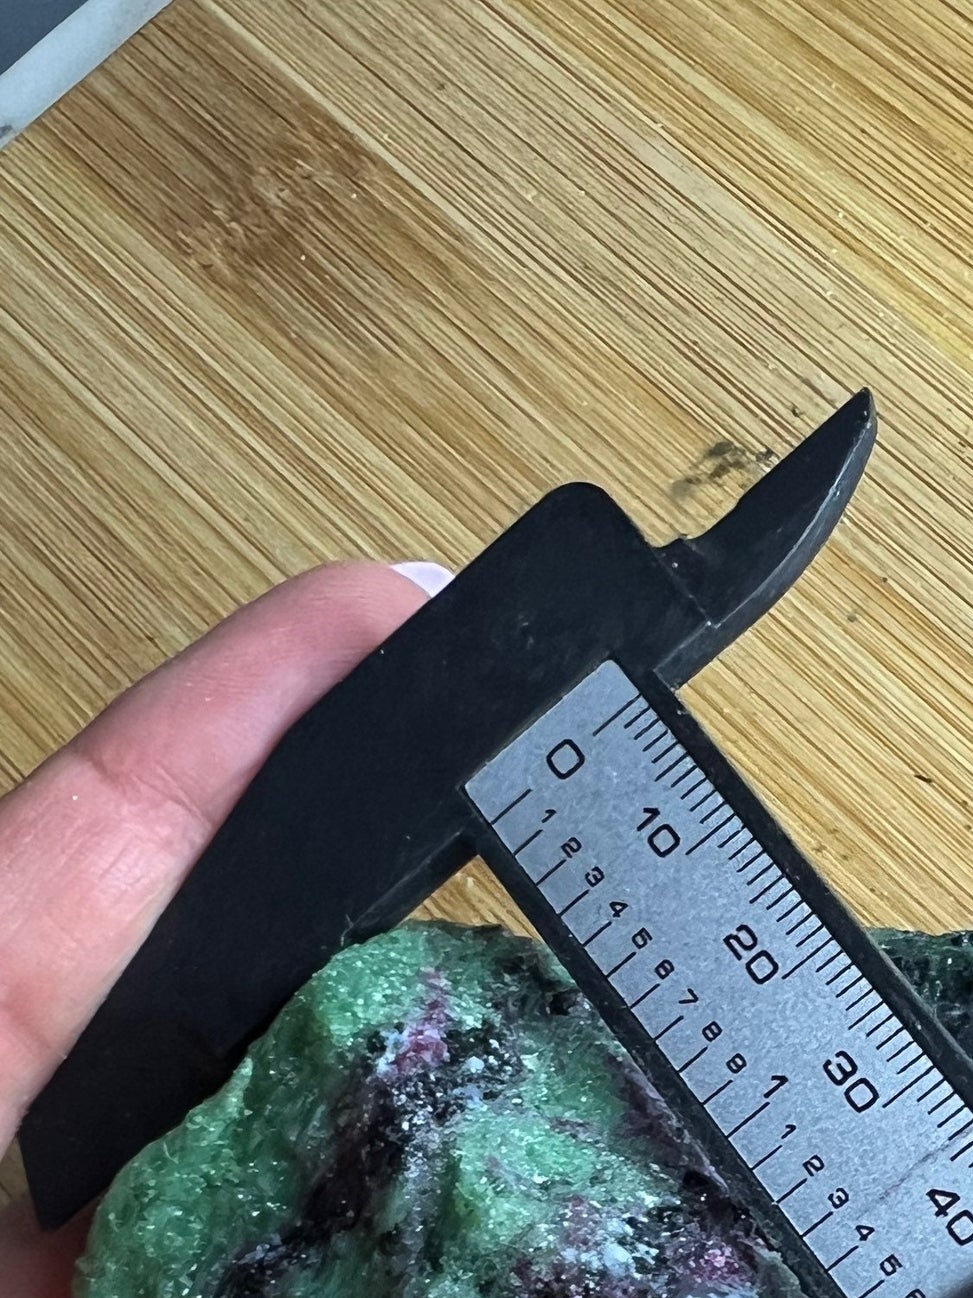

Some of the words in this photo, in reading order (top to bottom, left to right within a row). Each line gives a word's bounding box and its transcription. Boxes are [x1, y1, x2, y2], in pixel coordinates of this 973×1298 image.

[542, 809, 557, 823] 1
[560, 837, 582, 858] 2
[585, 866, 605, 887] 3
[608, 901, 629, 918] 4
[632, 928, 652, 949] 5
[679, 988, 698, 1004] 7
[702, 1021, 722, 1042] 8
[763, 1075, 788, 1098] 1
[781, 1124, 796, 1139] 1
[802, 1155, 824, 1176] 2
[828, 1188, 849, 1209] 3
[855, 1225, 875, 1241] 4
[880, 1254, 903, 1276] 5
[546, 739, 585, 779] 0
[637, 808, 680, 858] 10
[723, 924, 779, 984] 20
[823, 1050, 880, 1113] 30
